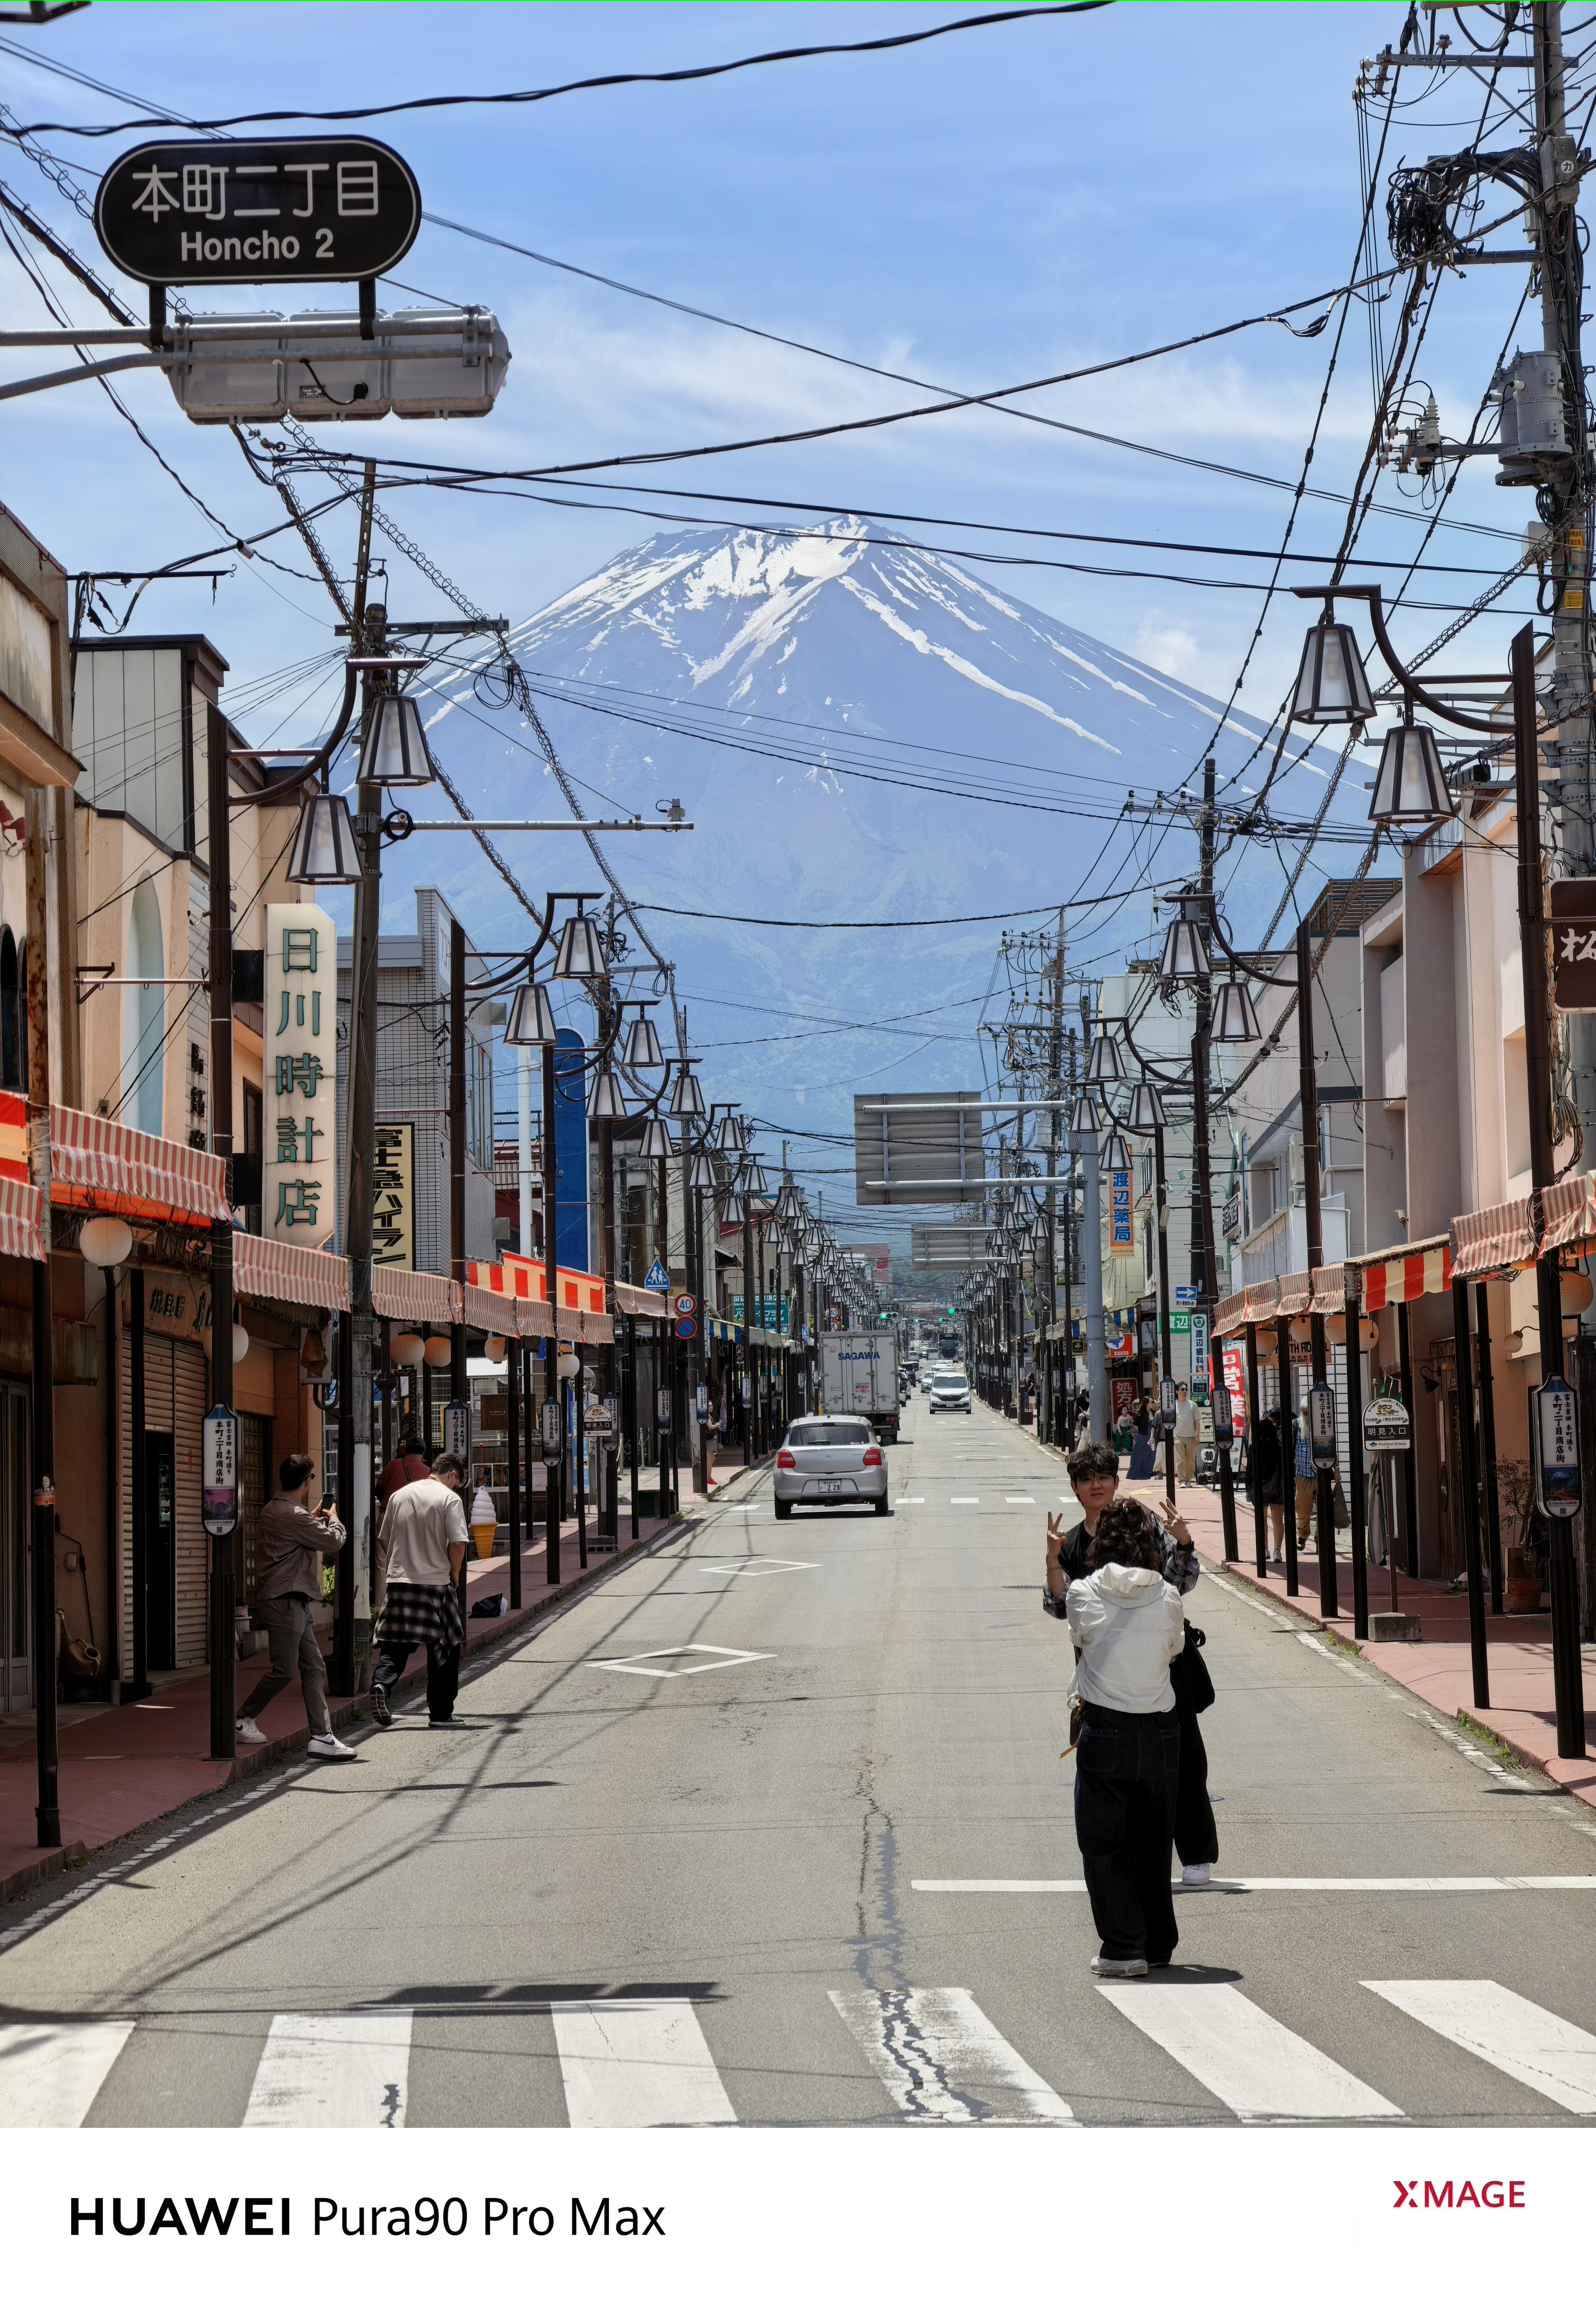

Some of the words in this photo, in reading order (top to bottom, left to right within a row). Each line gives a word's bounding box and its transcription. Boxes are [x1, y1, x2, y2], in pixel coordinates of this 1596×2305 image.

[131, 160, 379, 223] 本町二丁目
[181, 229, 300, 261] Honcho
[315, 228, 335, 258] 2
[275, 927, 325, 1230] 日川時計店
[1112, 1171, 1131, 1242] 渡辺薬局
[680, 1300, 691, 1309] 40
[1169, 1315, 1190, 1329] 渡辺
[838, 1351, 881, 1361] SAGAWA
[1195, 1329, 1204, 1365] 渡辺歯科
[1275, 1343, 1299, 1354] YTH
[1301, 1342, 1329, 1353] HOL
[1368, 1427, 1406, 1436] 明見入口
[1553, 1394, 1565, 1463] 本町二丁目商店街
[215, 1420, 224, 1485] 本町二丁目商店街
